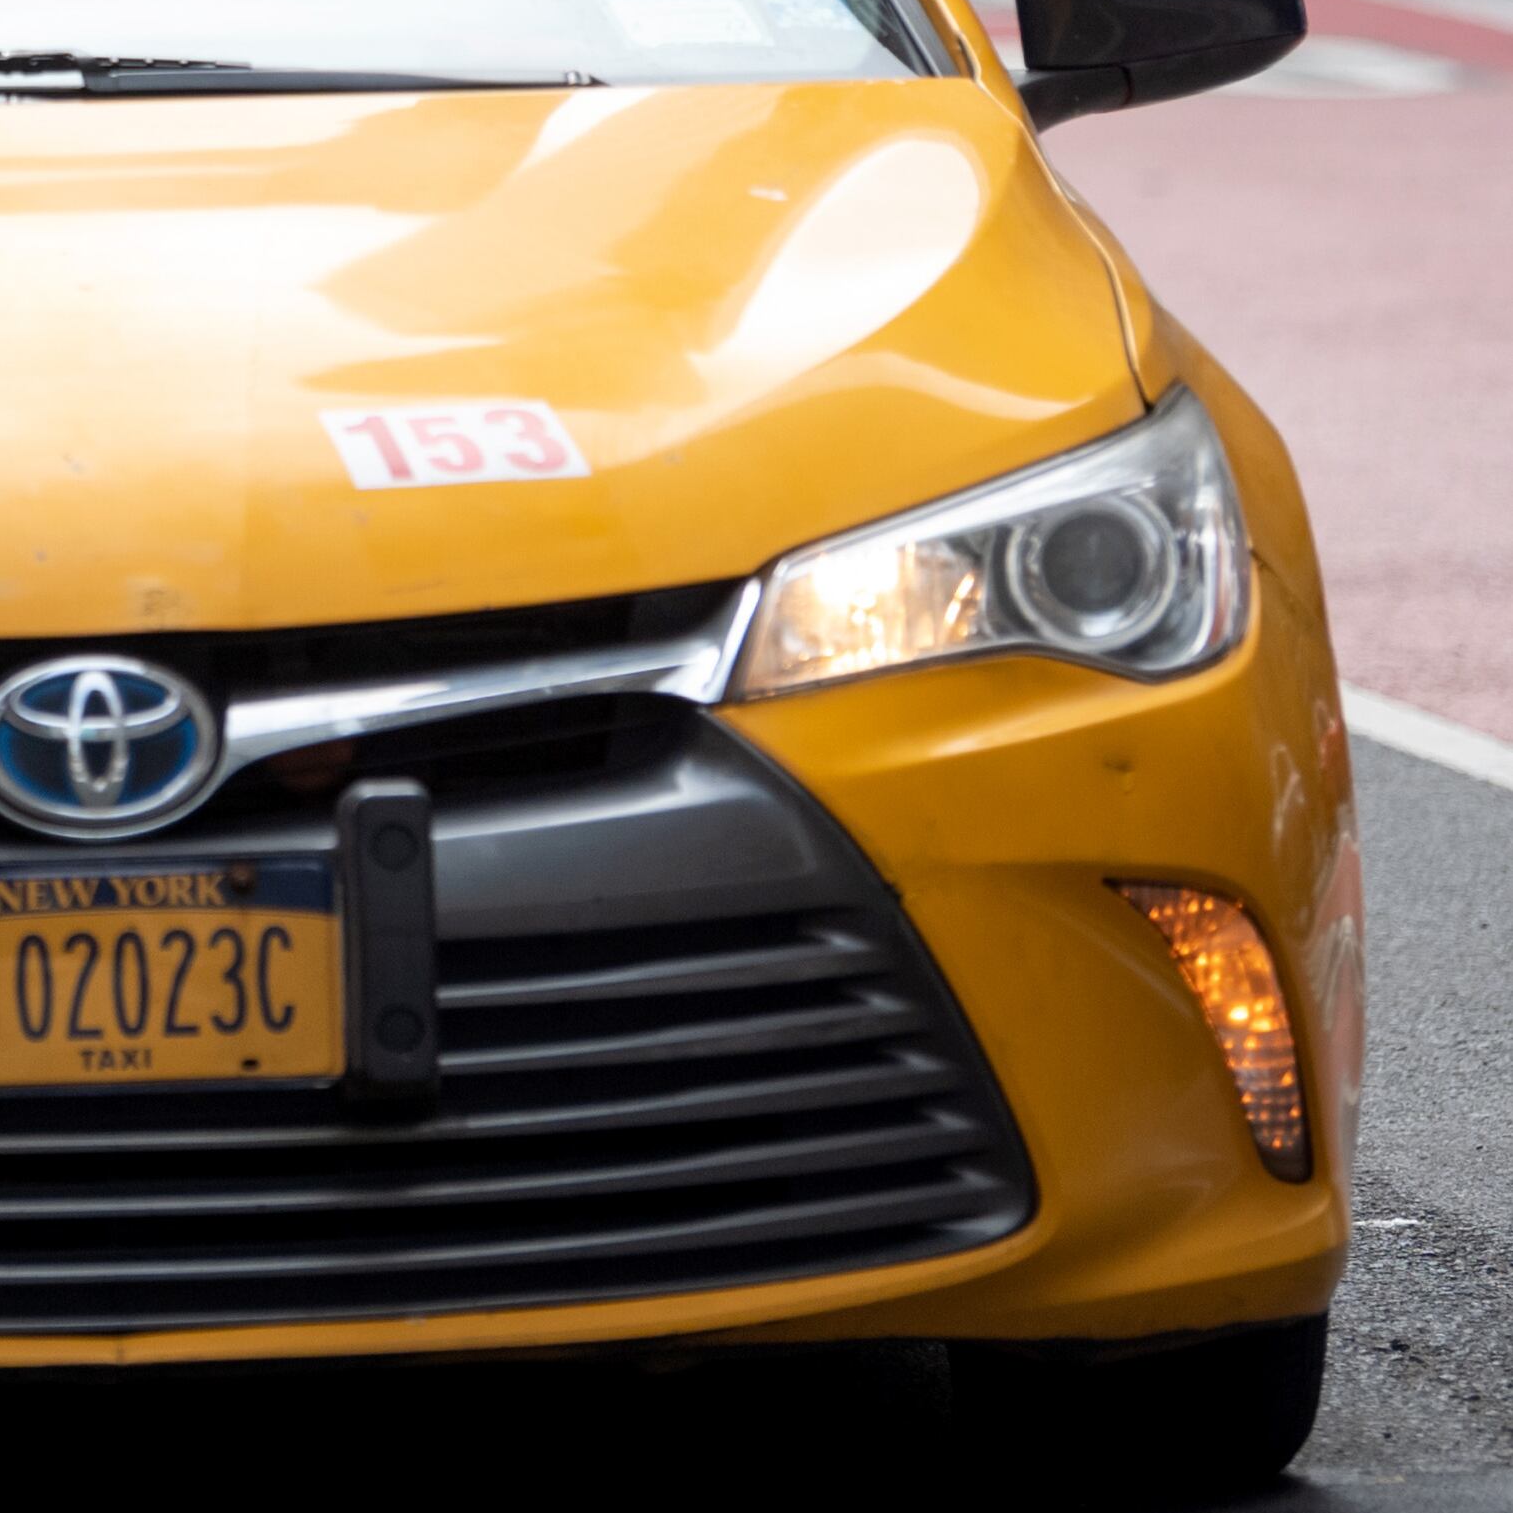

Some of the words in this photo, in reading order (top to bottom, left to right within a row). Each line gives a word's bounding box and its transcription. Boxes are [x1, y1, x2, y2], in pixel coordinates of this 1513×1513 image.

[342, 409, 570, 481] 153
[109, 873, 228, 909] YORK
[80, 1047, 153, 1073] TAXI
